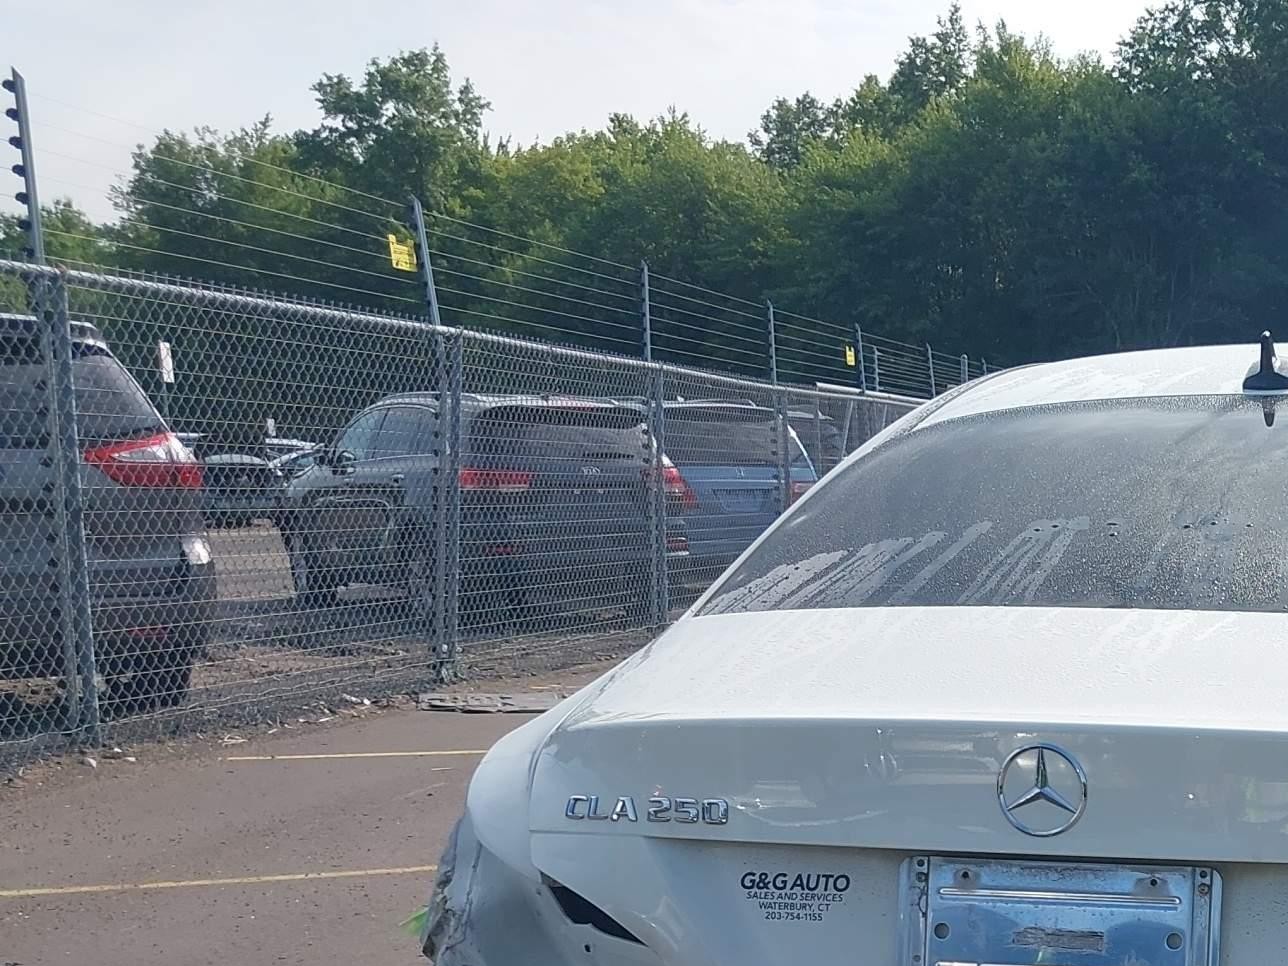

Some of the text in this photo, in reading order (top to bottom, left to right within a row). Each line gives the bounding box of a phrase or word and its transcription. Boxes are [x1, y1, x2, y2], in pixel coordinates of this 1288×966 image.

[565, 795, 729, 825] CLA 250
[740, 872, 850, 892] G&G AUTO
[746, 891, 843, 902] SALES AND SERVICES
[759, 901, 831, 912] WATERBURY, CT
[765, 911, 823, 921] 203-754-1155
